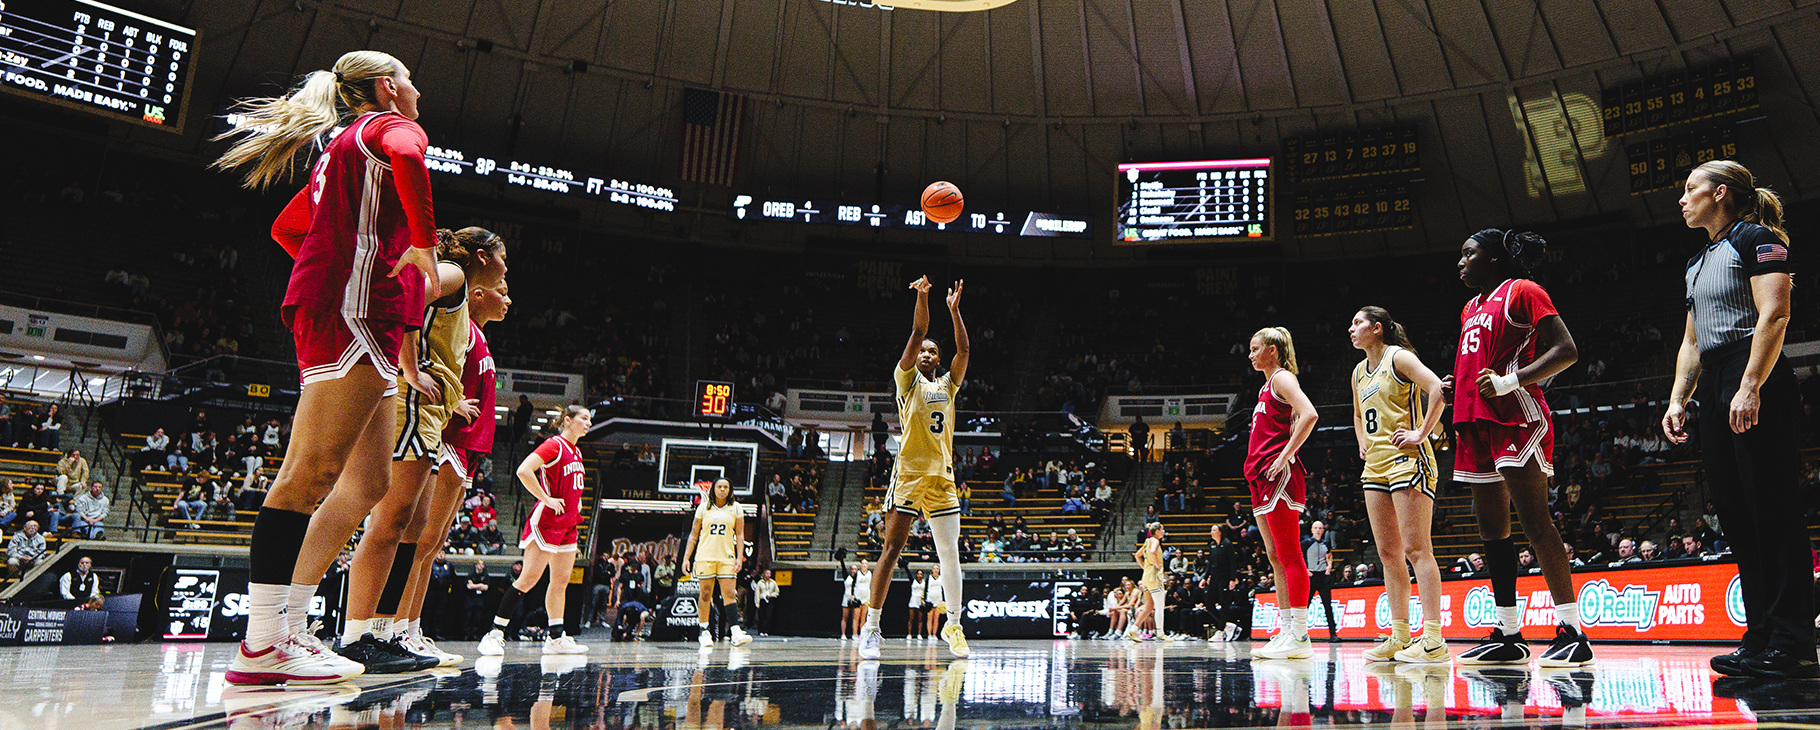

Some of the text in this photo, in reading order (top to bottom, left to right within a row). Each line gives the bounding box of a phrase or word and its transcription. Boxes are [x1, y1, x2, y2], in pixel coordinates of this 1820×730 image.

[73, 11, 188, 53] PTS REB AST BLK FOUL
[104, 31, 110, 41] 1
[125, 37, 134, 48] 0
[149, 44, 158, 54] 0
[172, 51, 181, 61] 0
[72, 45, 81, 55] 0
[121, 58, 130, 68] 0
[144, 65, 153, 75] 0
[168, 72, 177, 82] 0
[99, 42, 108, 52] 0
[125, 49, 130, 58] 1
[146, 55, 155, 65] 0
[170, 61, 179, 72] 0
[5, 71, 48, 92] FOOD.
[53, 83, 93, 102] MADE
[95, 63, 104, 74] 0
[120, 70, 126, 80] 1
[142, 76, 151, 87] 0
[165, 82, 174, 93] 0
[94, 76, 100, 85] 1
[117, 82, 123, 92] 1
[139, 88, 148, 98] 0
[163, 94, 172, 104] 0
[1604, 76, 1755, 120] 23 33 55 13 4 25 33
[1304, 142, 1416, 164] 27 13 7 23 37 19
[1630, 143, 1736, 176] 50 3 23 15
[586, 177, 604, 195] FT
[636, 183, 673, 198] 100.0%
[762, 201, 795, 218] OREB
[838, 205, 862, 222] REB
[1295, 199, 1410, 220] 32 35 43 42 10 22
[970, 213, 986, 229] TO
[858, 259, 904, 276] PAINT
[1196, 266, 1239, 282] PAINT
[1196, 280, 1238, 296] CREW
[1461, 327, 1480, 355] 45
[706, 384, 731, 397] 8:50
[702, 395, 726, 414] 30
[930, 410, 945, 434] 3
[1365, 407, 1378, 434] 8
[573, 472, 585, 490] 10
[621, 489, 652, 499] TIME
[710, 523, 726, 536] 22
[1663, 583, 1701, 604] AUTO
[967, 599, 1051, 619] SEATGEEK
[1579, 580, 1657, 631] O'Reilly
[1658, 604, 1704, 625] PARTS
[24, 629, 63, 642] CARPENTERS
